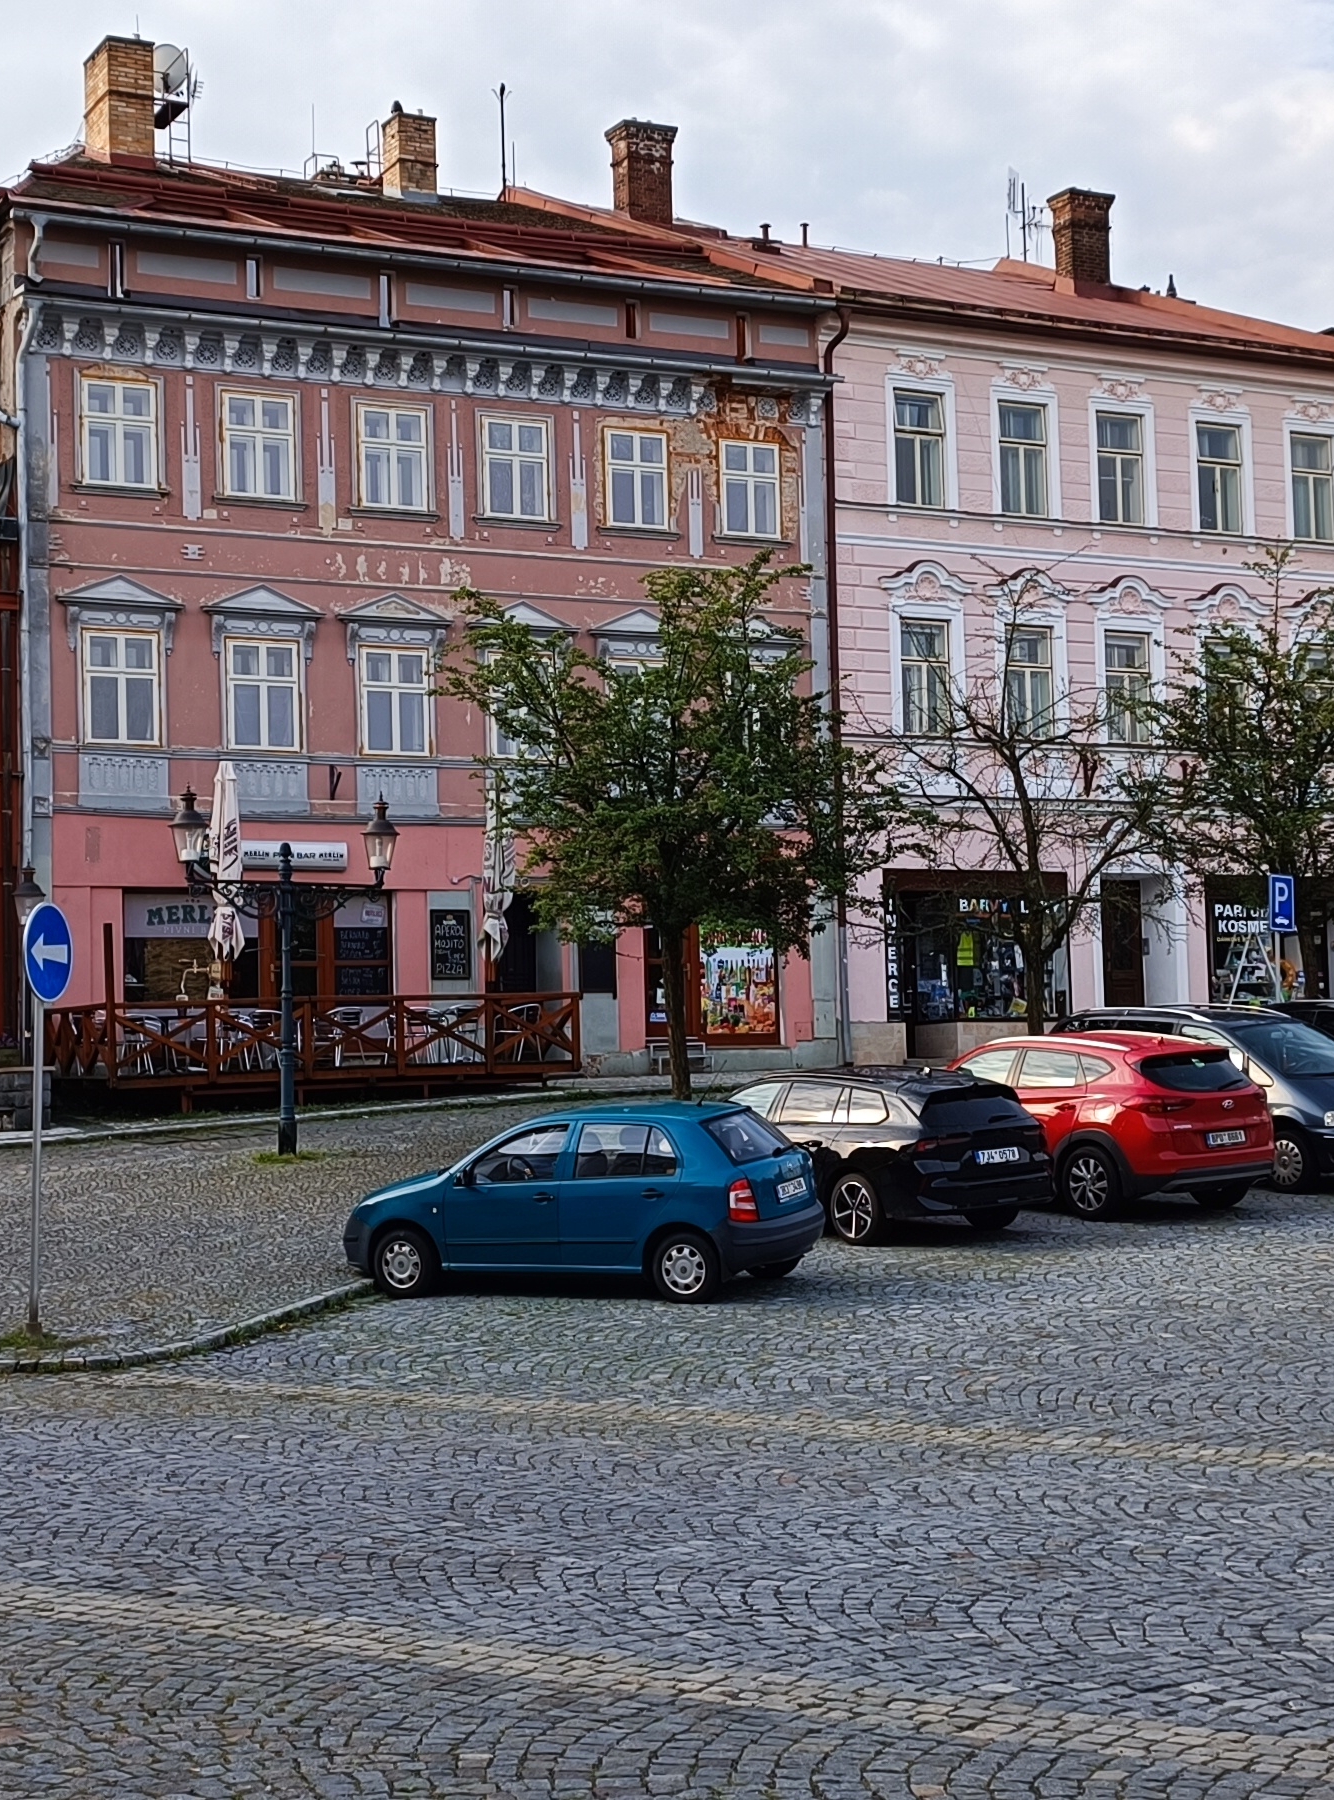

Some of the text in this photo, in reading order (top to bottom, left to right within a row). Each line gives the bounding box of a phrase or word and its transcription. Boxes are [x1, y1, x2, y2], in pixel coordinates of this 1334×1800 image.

[244, 850, 270, 858] MERLIN
[1274, 881, 1289, 913] P
[146, 904, 215, 926] MERL
[434, 924, 466, 937] APEROL
[434, 939, 465, 949] MOJITO
[436, 963, 463, 975] PIZZA
